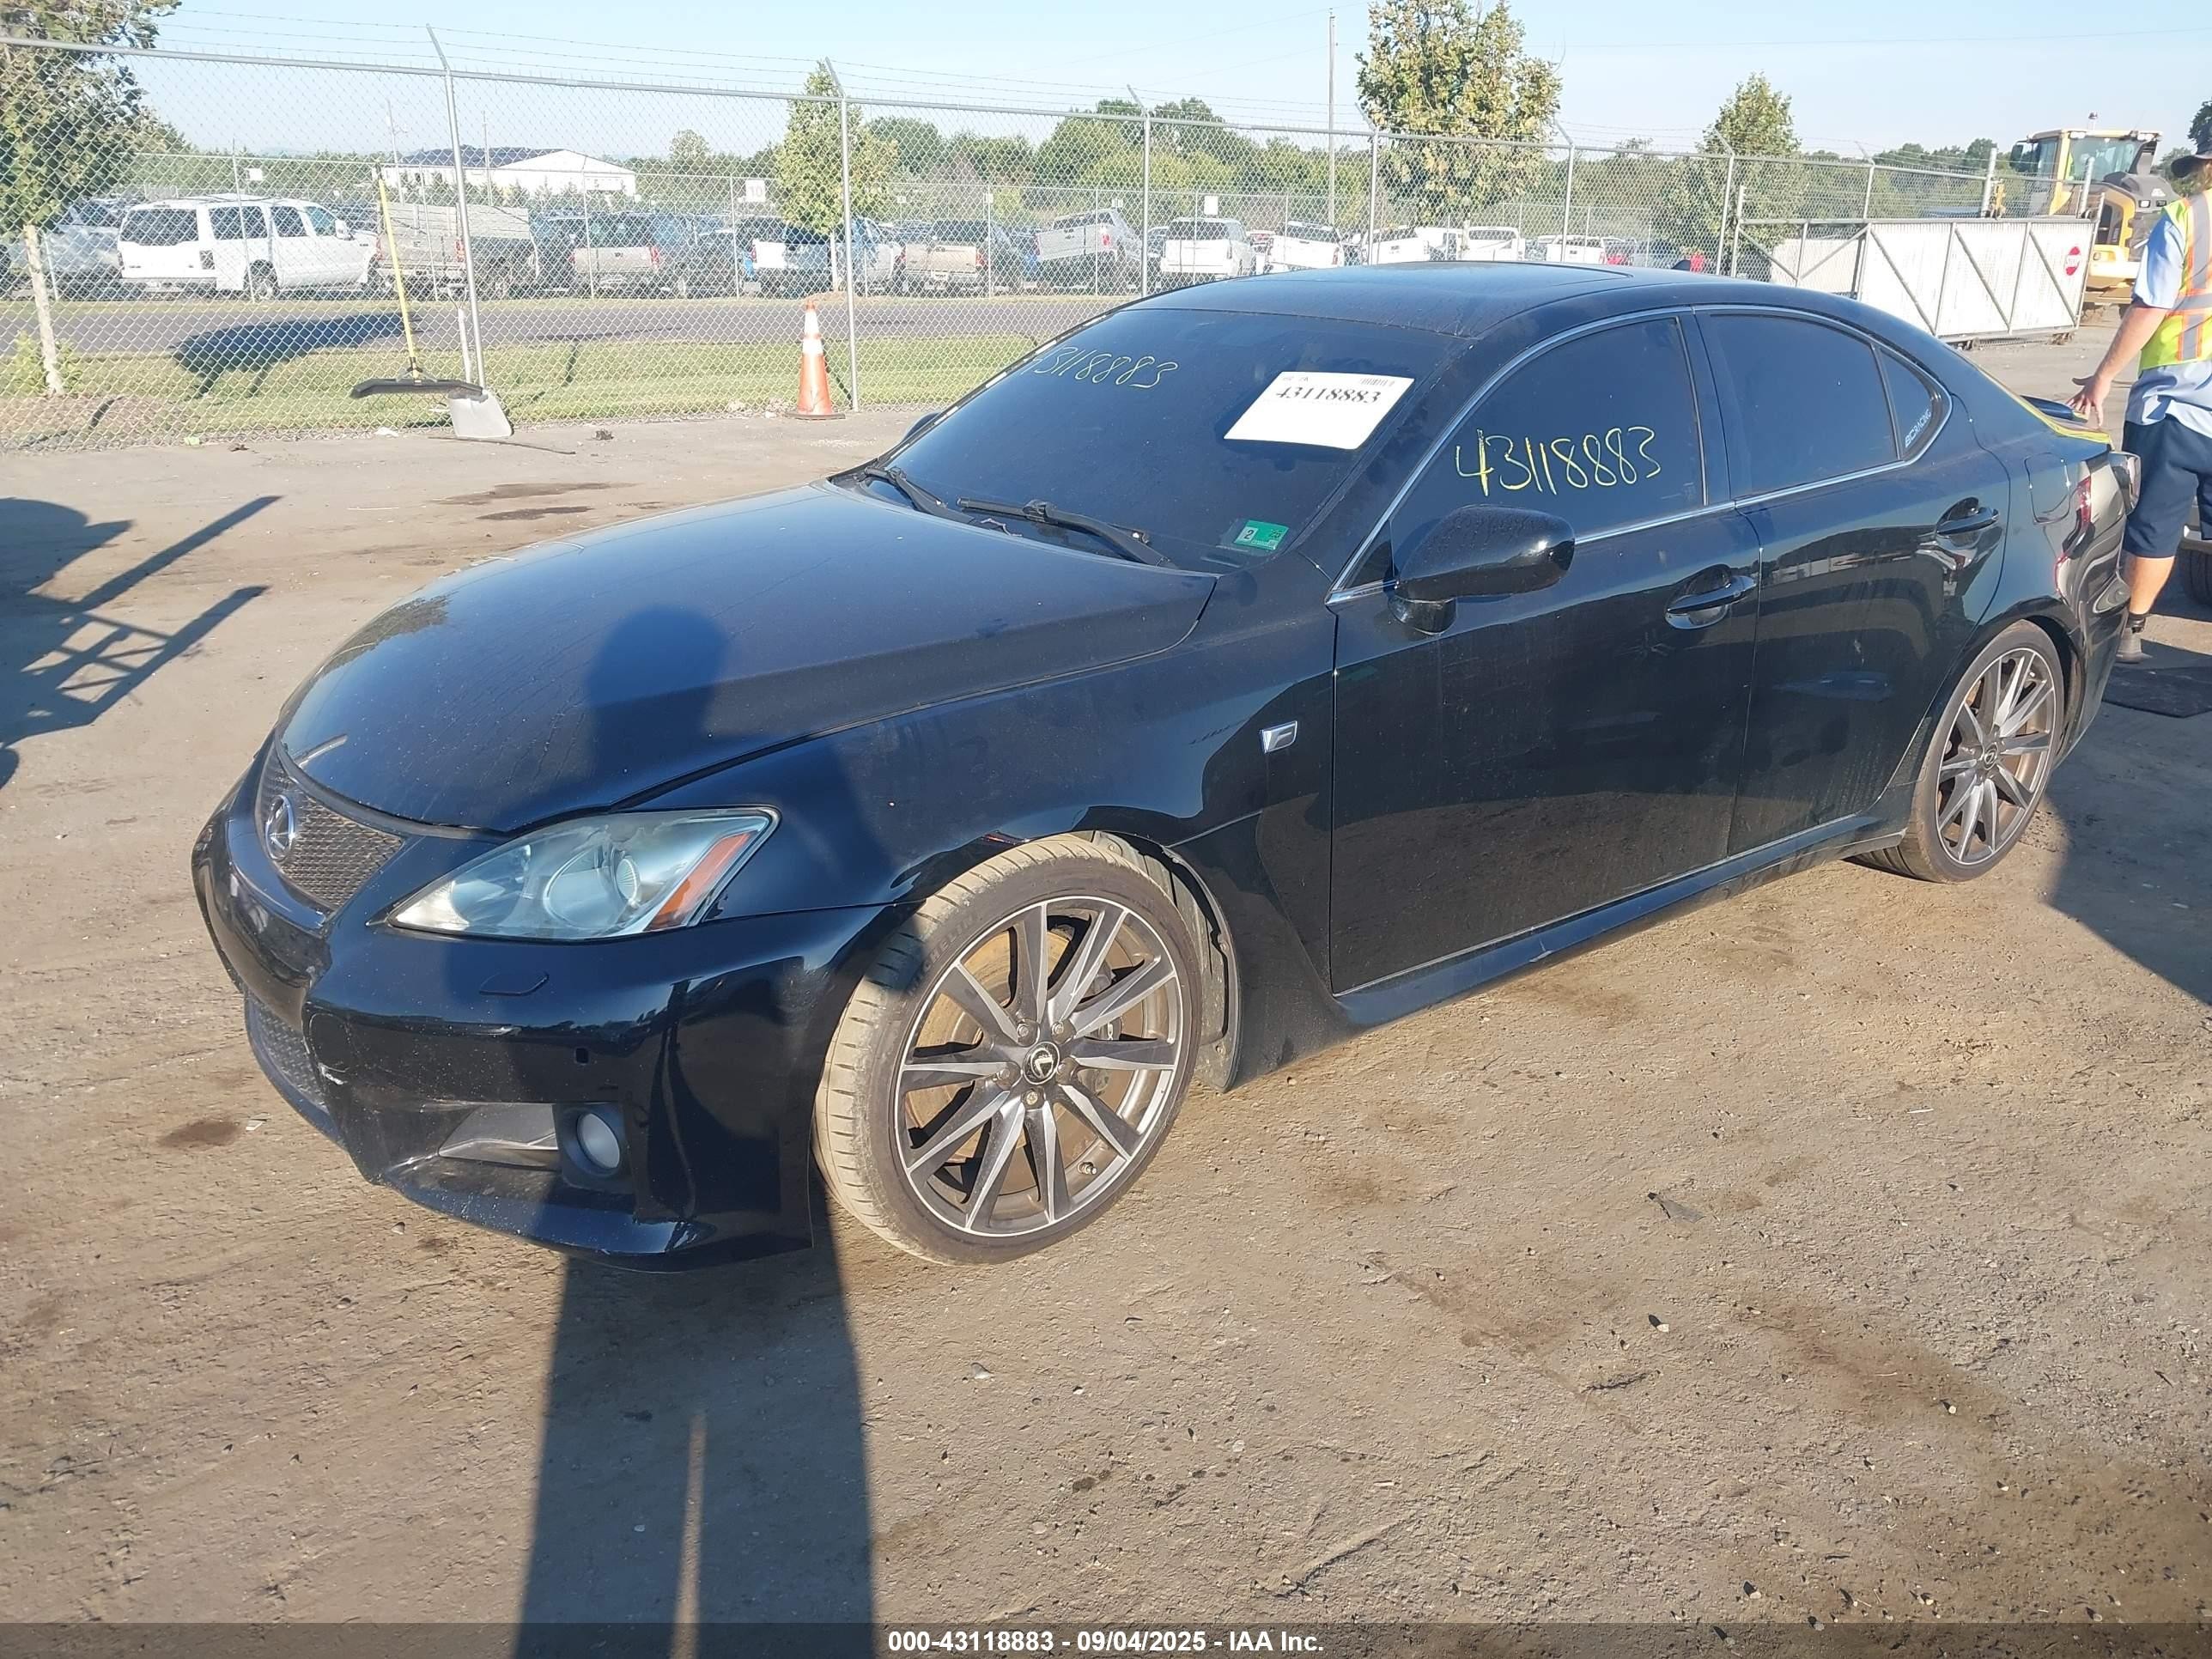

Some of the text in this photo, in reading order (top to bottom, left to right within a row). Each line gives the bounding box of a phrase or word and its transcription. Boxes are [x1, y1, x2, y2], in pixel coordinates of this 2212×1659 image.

[1276, 386, 1382, 404] 43118883
[1455, 426, 1662, 496] 43118883
[1243, 529, 1255, 539] 2
